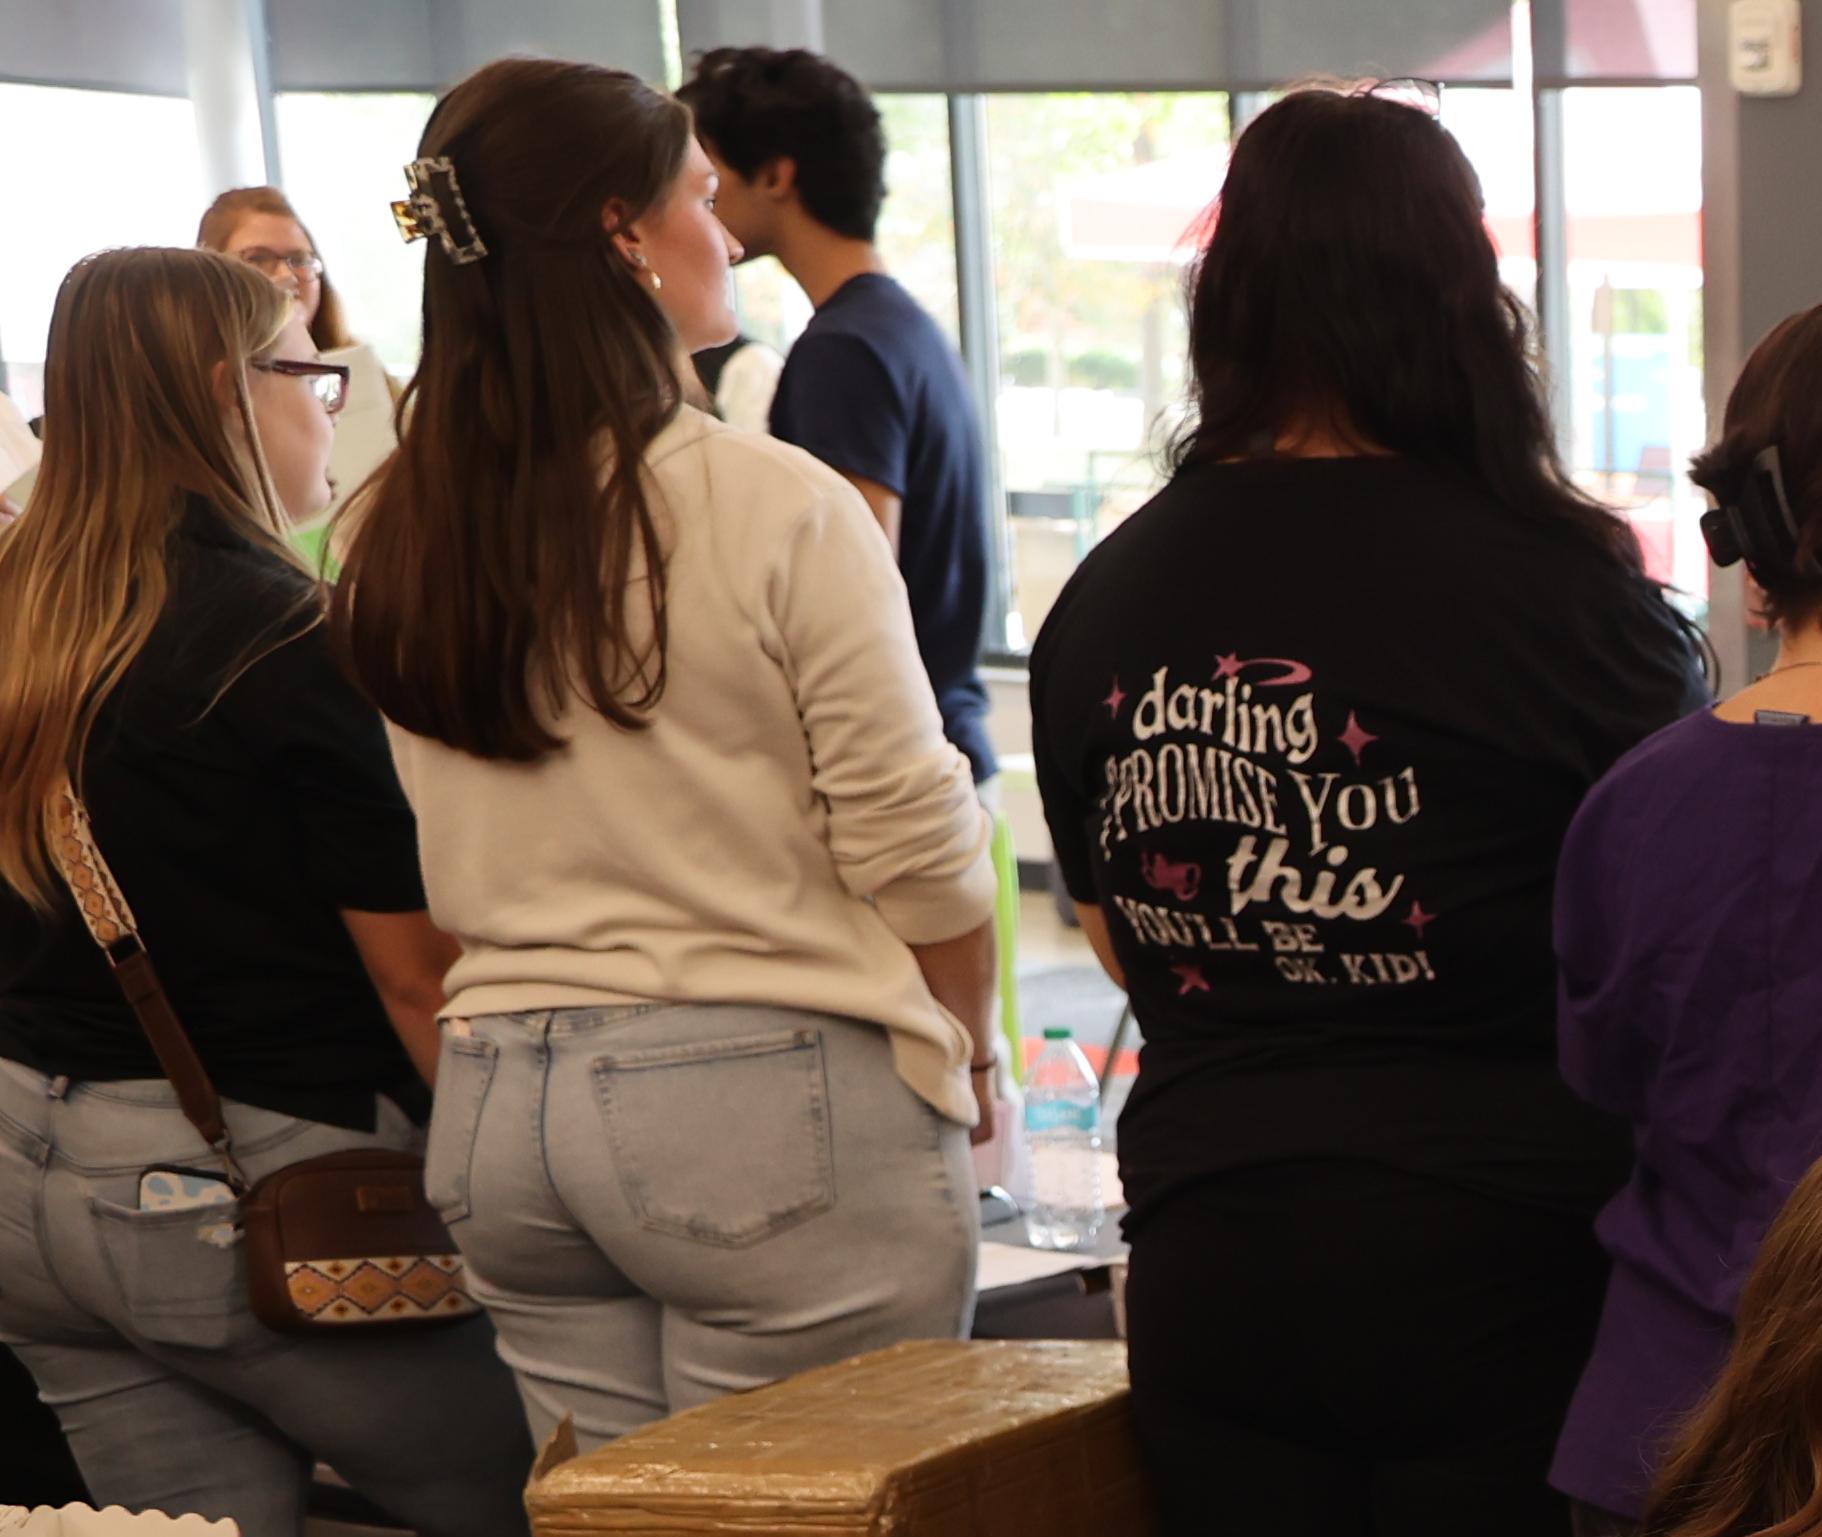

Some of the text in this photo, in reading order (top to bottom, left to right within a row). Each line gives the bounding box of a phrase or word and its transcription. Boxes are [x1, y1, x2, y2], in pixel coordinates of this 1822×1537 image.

[1133, 666, 1318, 764] darling
[1113, 744, 1287, 842] PROMISE
[1226, 835, 1404, 920] this
[1262, 921, 1324, 952] BE
[1340, 951, 1436, 985] KID!
